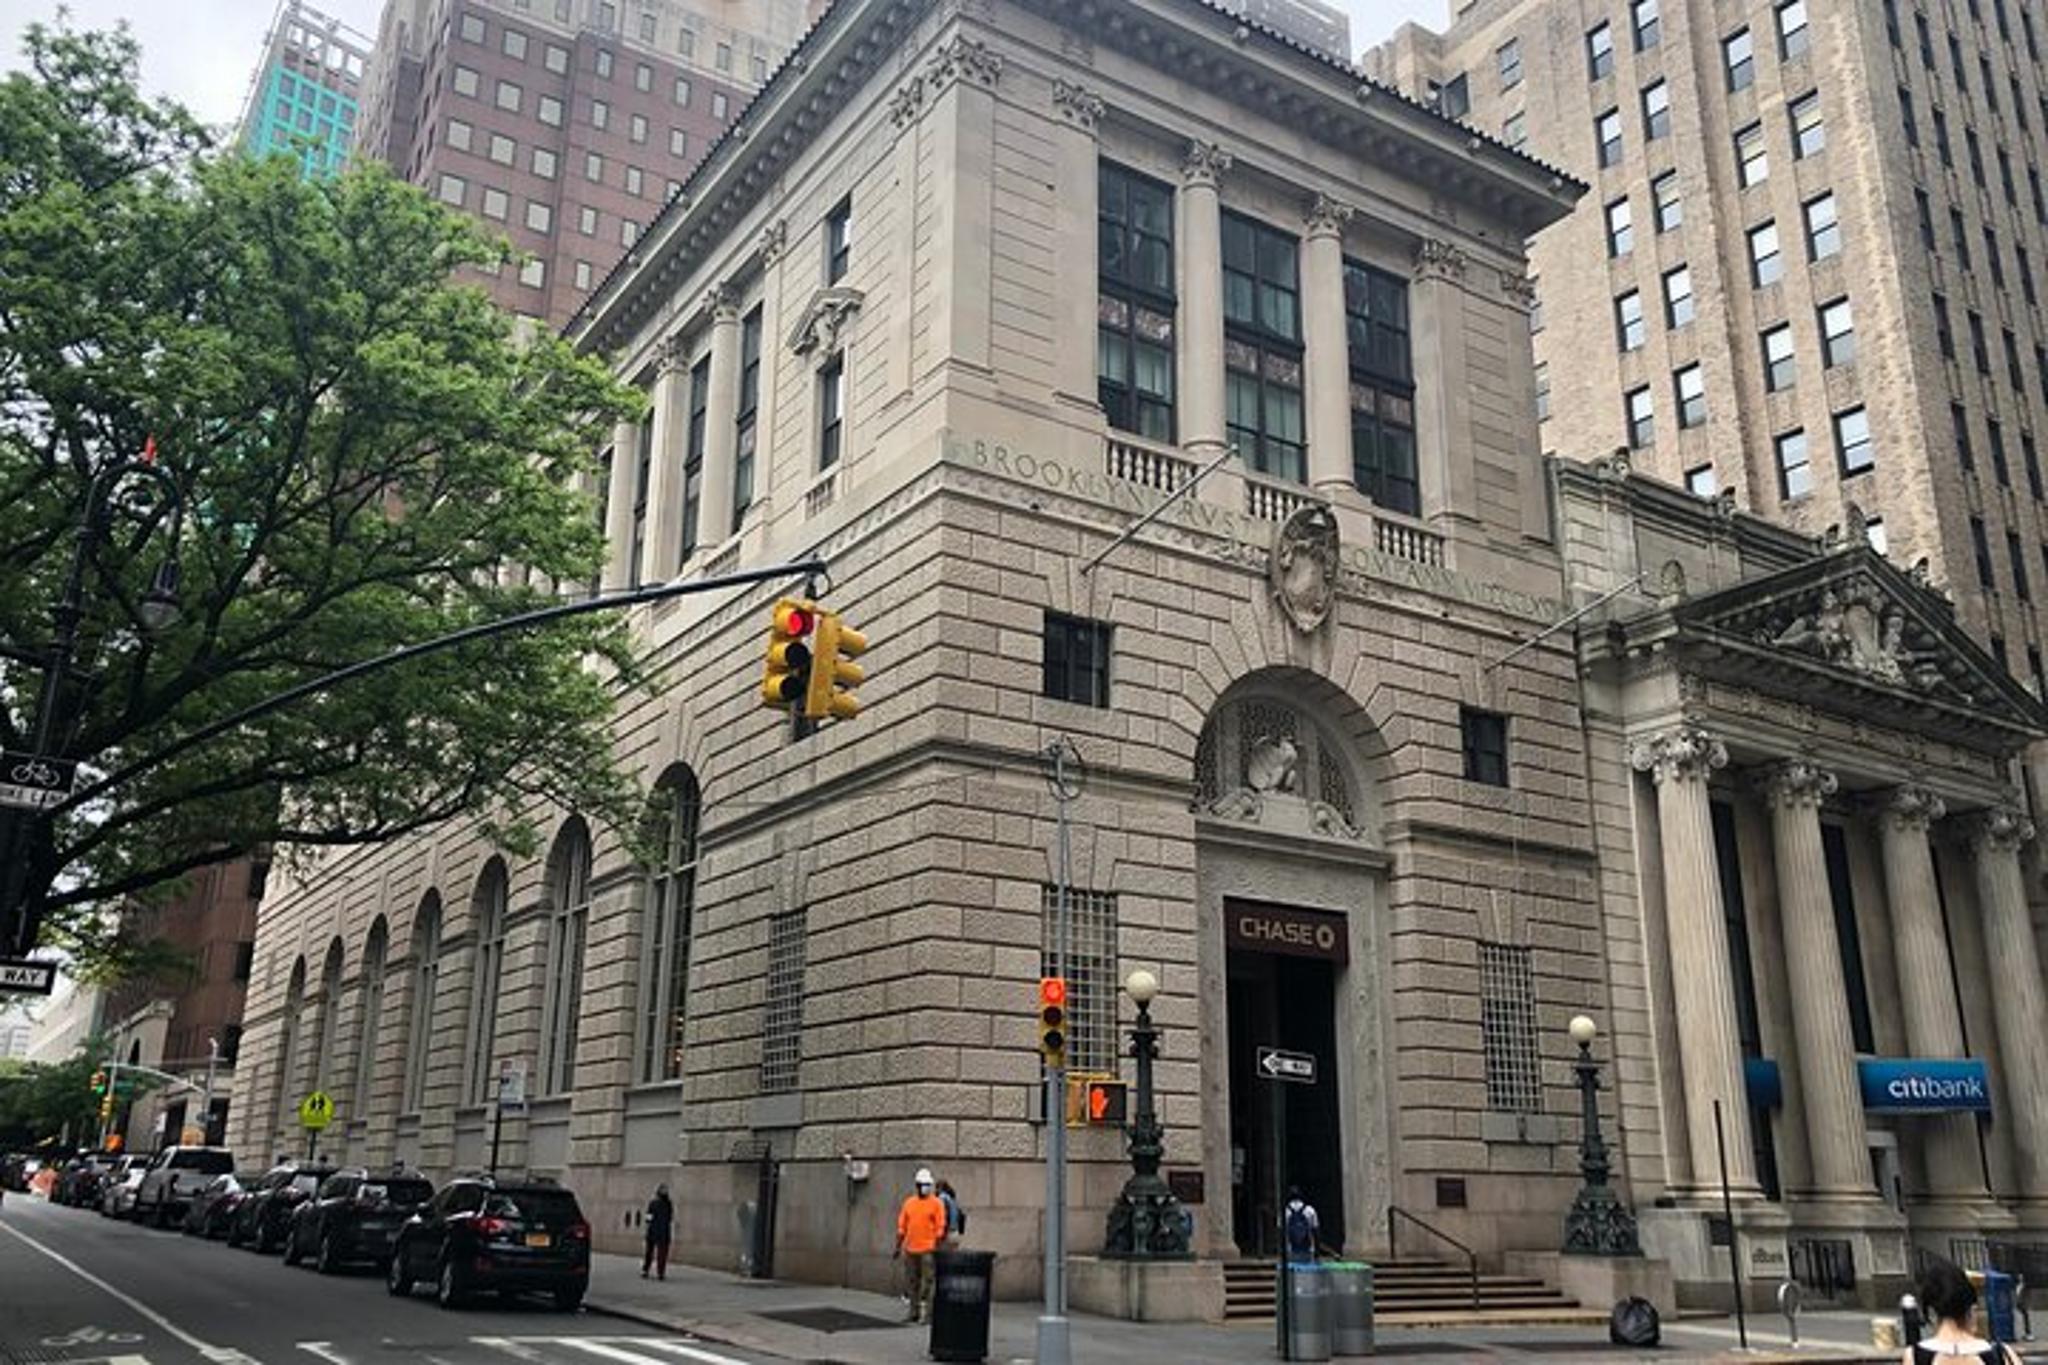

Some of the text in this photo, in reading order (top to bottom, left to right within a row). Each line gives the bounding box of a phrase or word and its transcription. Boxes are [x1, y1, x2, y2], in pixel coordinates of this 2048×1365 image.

[1239, 917, 1314, 945] CHASE
[4, 968, 41, 983] WAY
[1888, 1076, 1984, 1099] citibank
